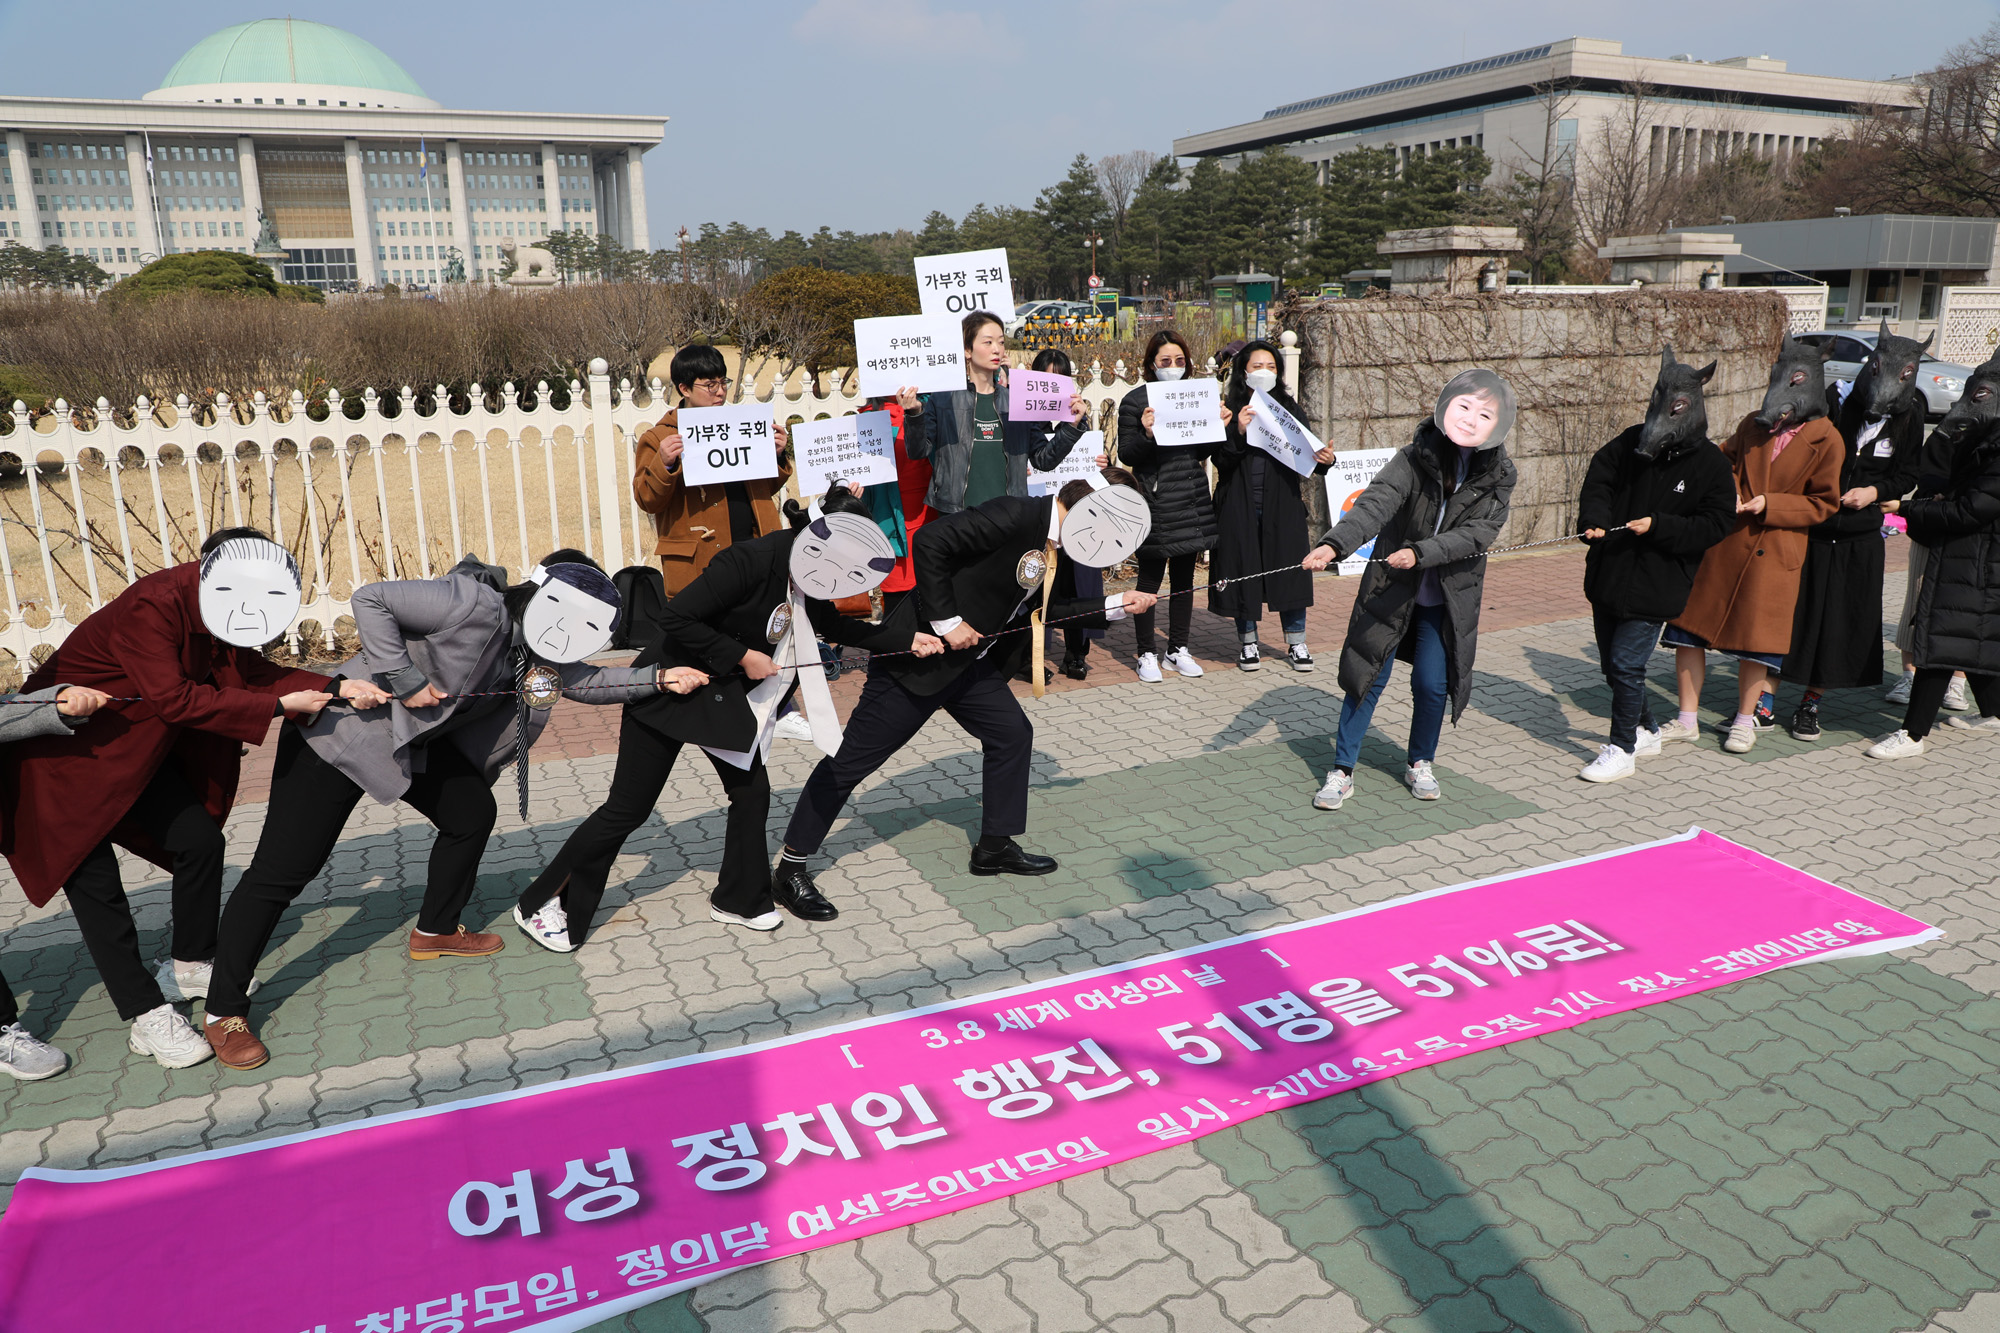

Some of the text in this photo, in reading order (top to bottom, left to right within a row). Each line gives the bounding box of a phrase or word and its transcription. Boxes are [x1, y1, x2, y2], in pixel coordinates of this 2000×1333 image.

[924, 267, 1003, 290] 가부장 국회
[946, 292, 989, 313] OUT
[889, 336, 932, 350] 우리에겐
[867, 353, 958, 371] 여성정치가 필요해
[1026, 380, 1061, 394] 51명을
[1165, 392, 1177, 400] 국회
[1198, 390, 1209, 398] 여성
[1025, 400, 1062, 412] 51%로!
[686, 420, 768, 443] 가부장 국회
[860, 429, 873, 437] 여성
[1181, 430, 1194, 438] 24%
[707, 446, 752, 468] OUT
[842, 465, 871, 477] 민주주의
[1344, 472, 1362, 483] 여성
[920, 1019, 987, 1050] 3.8
[994, 998, 1072, 1033] 세계
[1074, 973, 1184, 1010] 여성의
[1181, 963, 1226, 988] 날
[447, 918, 1625, 1237] 여성 정치인 행진, 51명을 51%로!
[616, 1220, 770, 1288] 정의당
[1137, 1097, 1230, 1141] 일시
[1461, 1013, 1541, 1040] 오전
